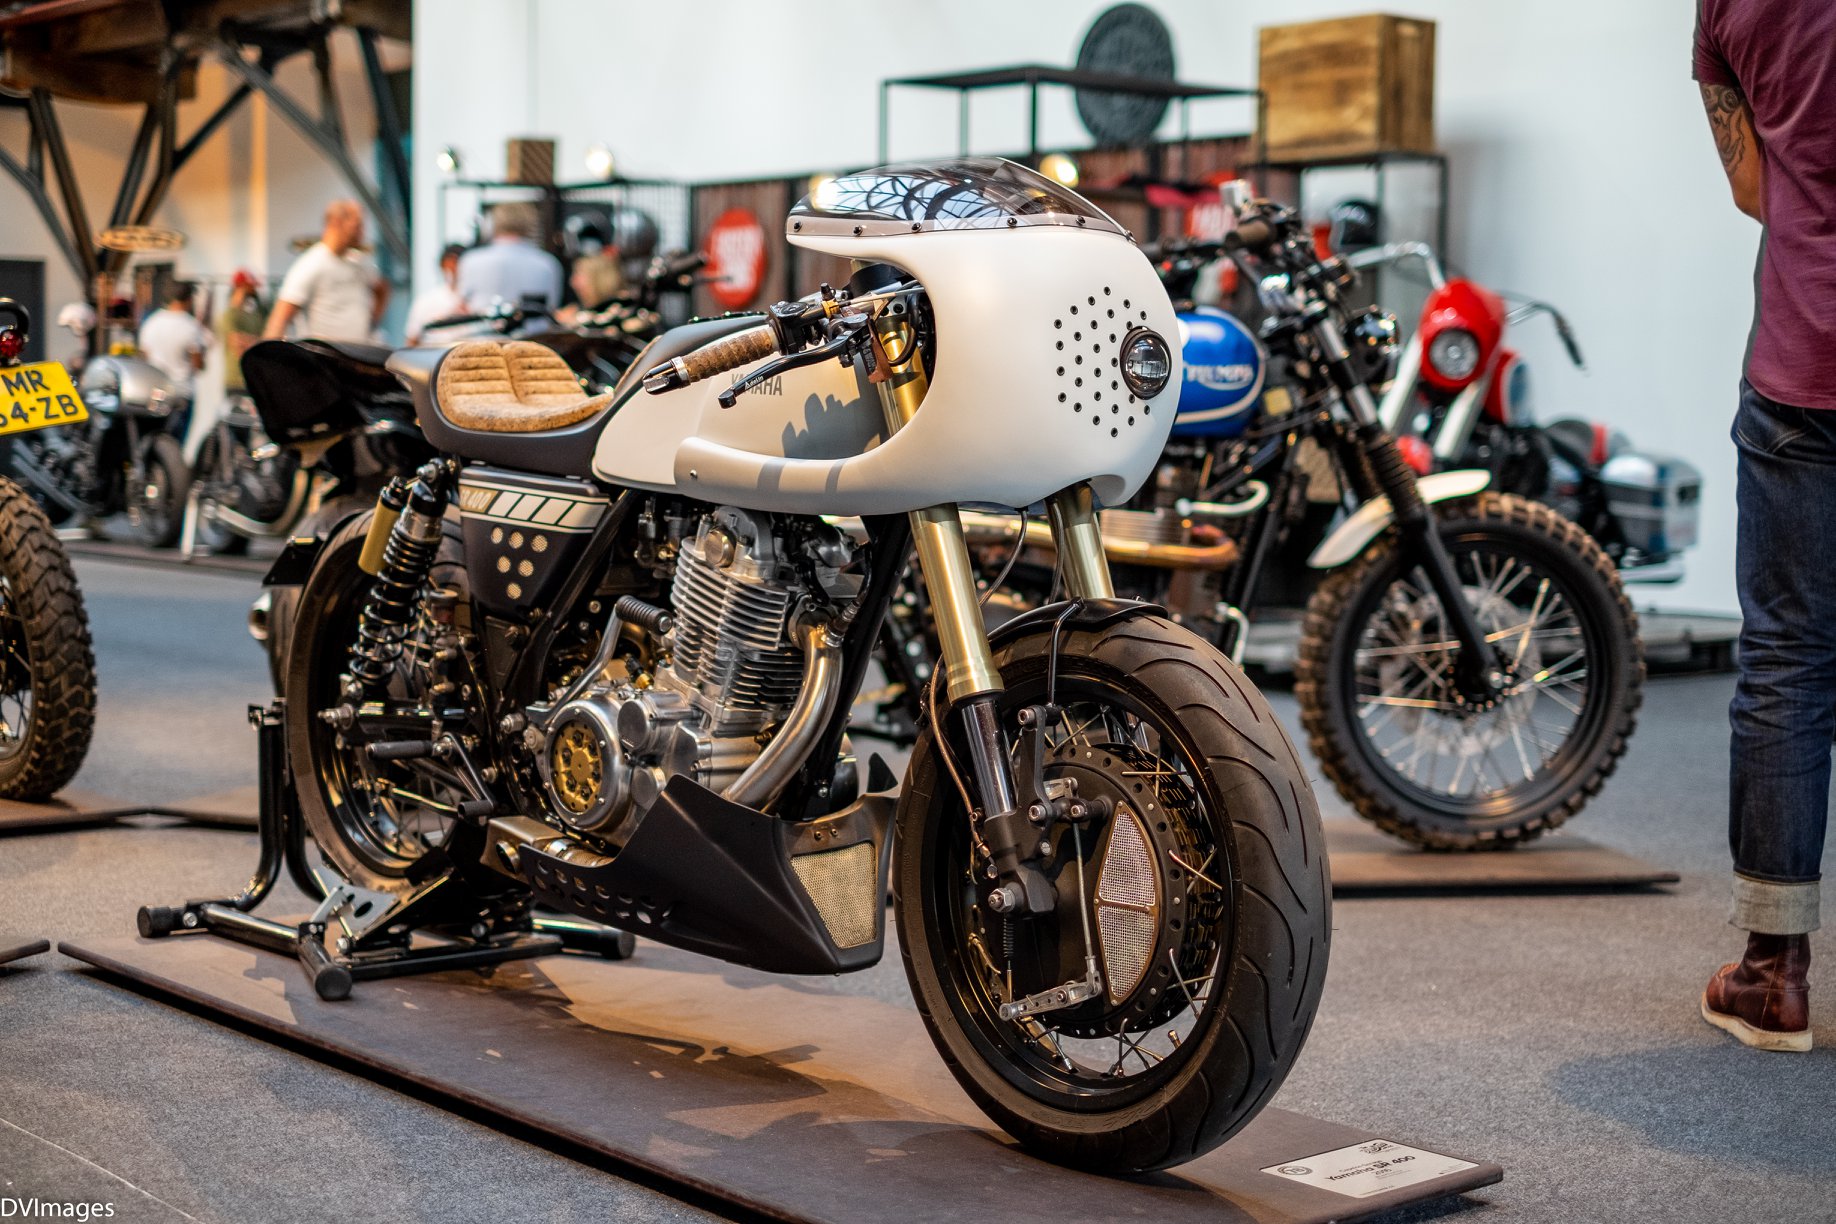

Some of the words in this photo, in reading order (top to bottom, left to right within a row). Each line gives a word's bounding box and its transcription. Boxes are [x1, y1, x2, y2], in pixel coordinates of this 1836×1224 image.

[1, 370, 50, 396] MR
[731, 373, 783, 396] YAHA
[1325, 1166, 1374, 1181] Yamaha
[1373, 1161, 1392, 1170] SR
[1392, 1155, 1416, 1165] 400
